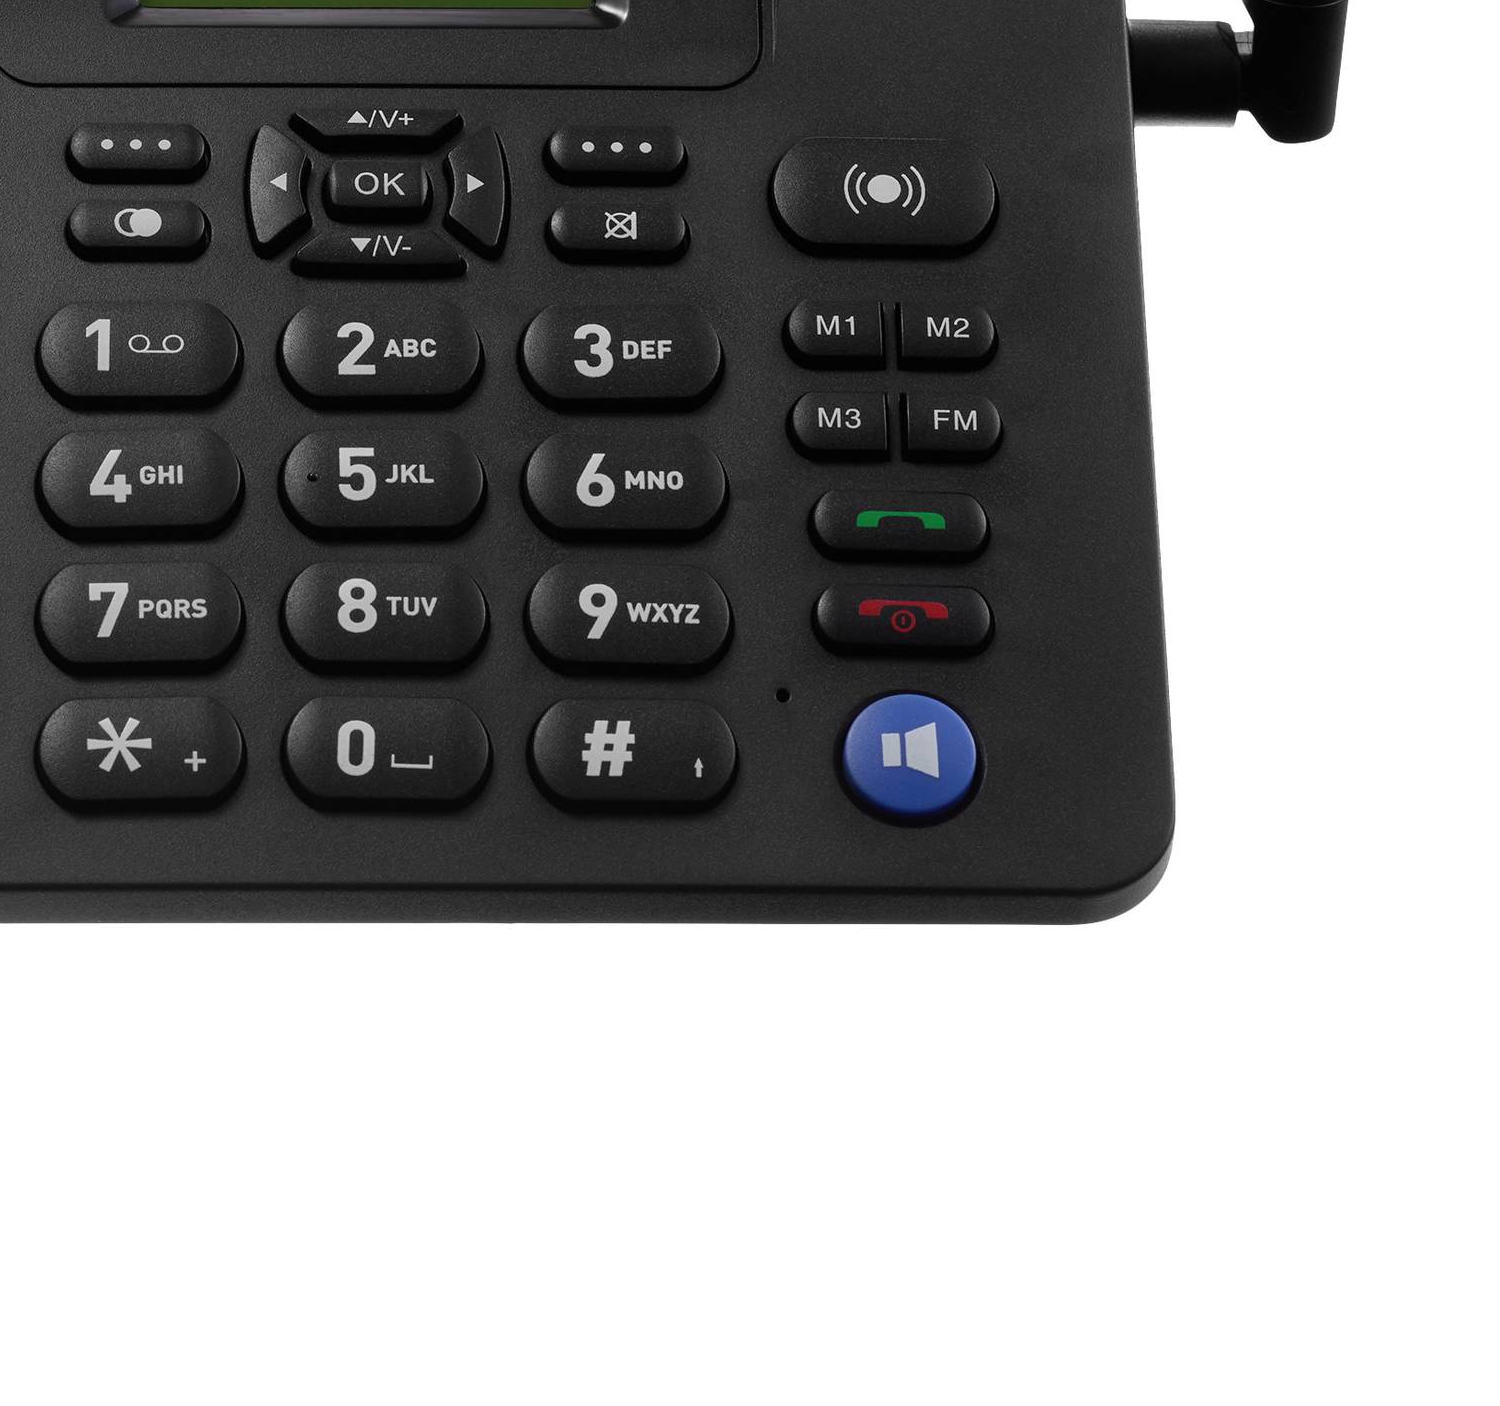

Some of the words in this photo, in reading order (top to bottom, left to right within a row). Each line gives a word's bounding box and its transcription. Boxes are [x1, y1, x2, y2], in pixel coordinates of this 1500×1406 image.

[354, 171, 406, 196] OK
[85, 318, 111, 372] 1
[336, 321, 377, 376] 2
[383, 337, 437, 358] ABC
[573, 323, 614, 378] 3
[622, 339, 673, 360] DEF
[816, 314, 858, 336] M1
[926, 316, 970, 339] M2
[817, 407, 862, 429] M3
[933, 409, 978, 431] FM
[89, 448, 133, 504] 4
[139, 464, 184, 485] GHI
[338, 446, 377, 502] 5
[384, 463, 435, 484] JKL
[575, 452, 616, 508] 6
[624, 470, 684, 491] MNO
[88, 582, 130, 638] 7
[138, 598, 208, 619] PQRS
[337, 577, 378, 634] 8
[385, 596, 438, 617] TUV
[578, 583, 618, 640] 9
[626, 601, 701, 625] WXYZ
[336, 719, 376, 777] 0
